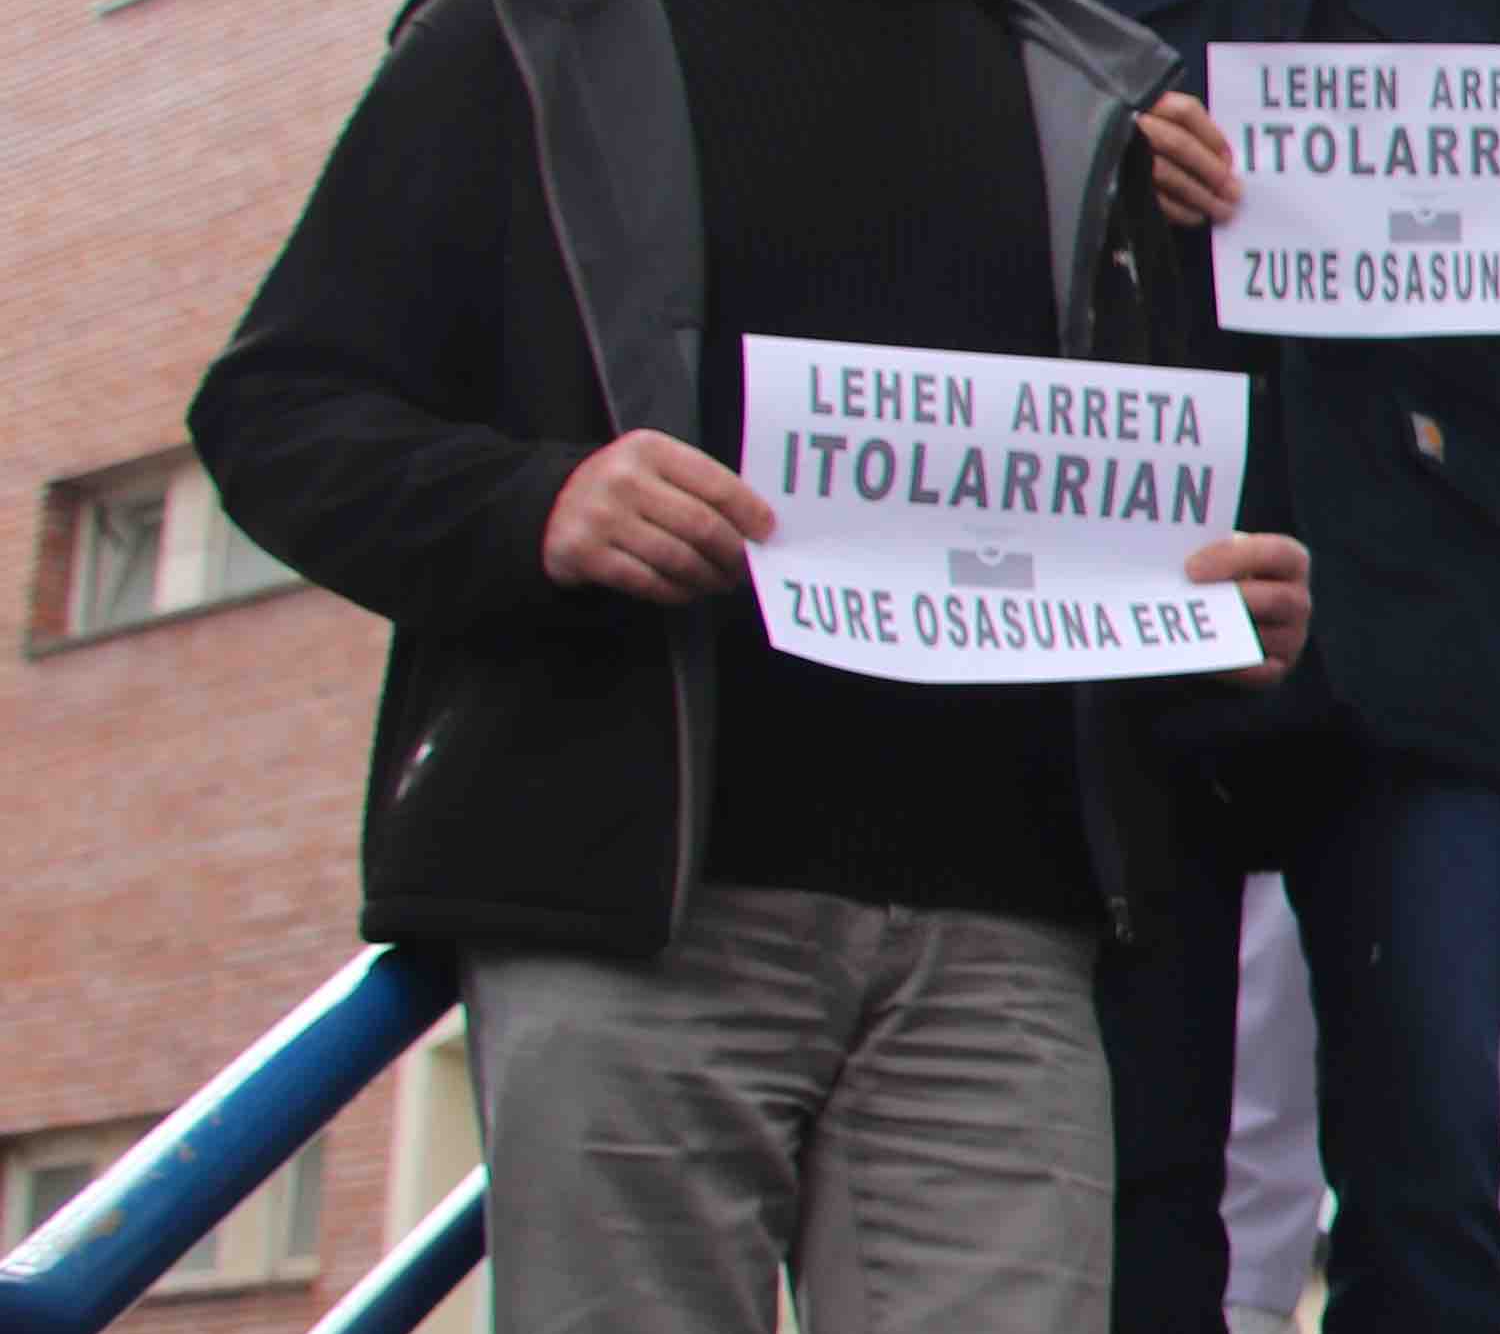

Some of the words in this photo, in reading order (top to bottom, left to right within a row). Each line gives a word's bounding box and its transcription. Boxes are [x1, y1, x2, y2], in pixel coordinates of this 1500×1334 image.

[1262, 66, 1398, 111] LEHEN
[1245, 250, 1338, 301] ZURE
[810, 365, 974, 427] LEHEN
[1013, 382, 1199, 446] ARRETA
[784, 431, 1212, 524] ITOLARRIAN
[785, 580, 898, 643] ZURE
[915, 593, 1120, 651] OSASUNA
[1136, 601, 1217, 645] ERE
